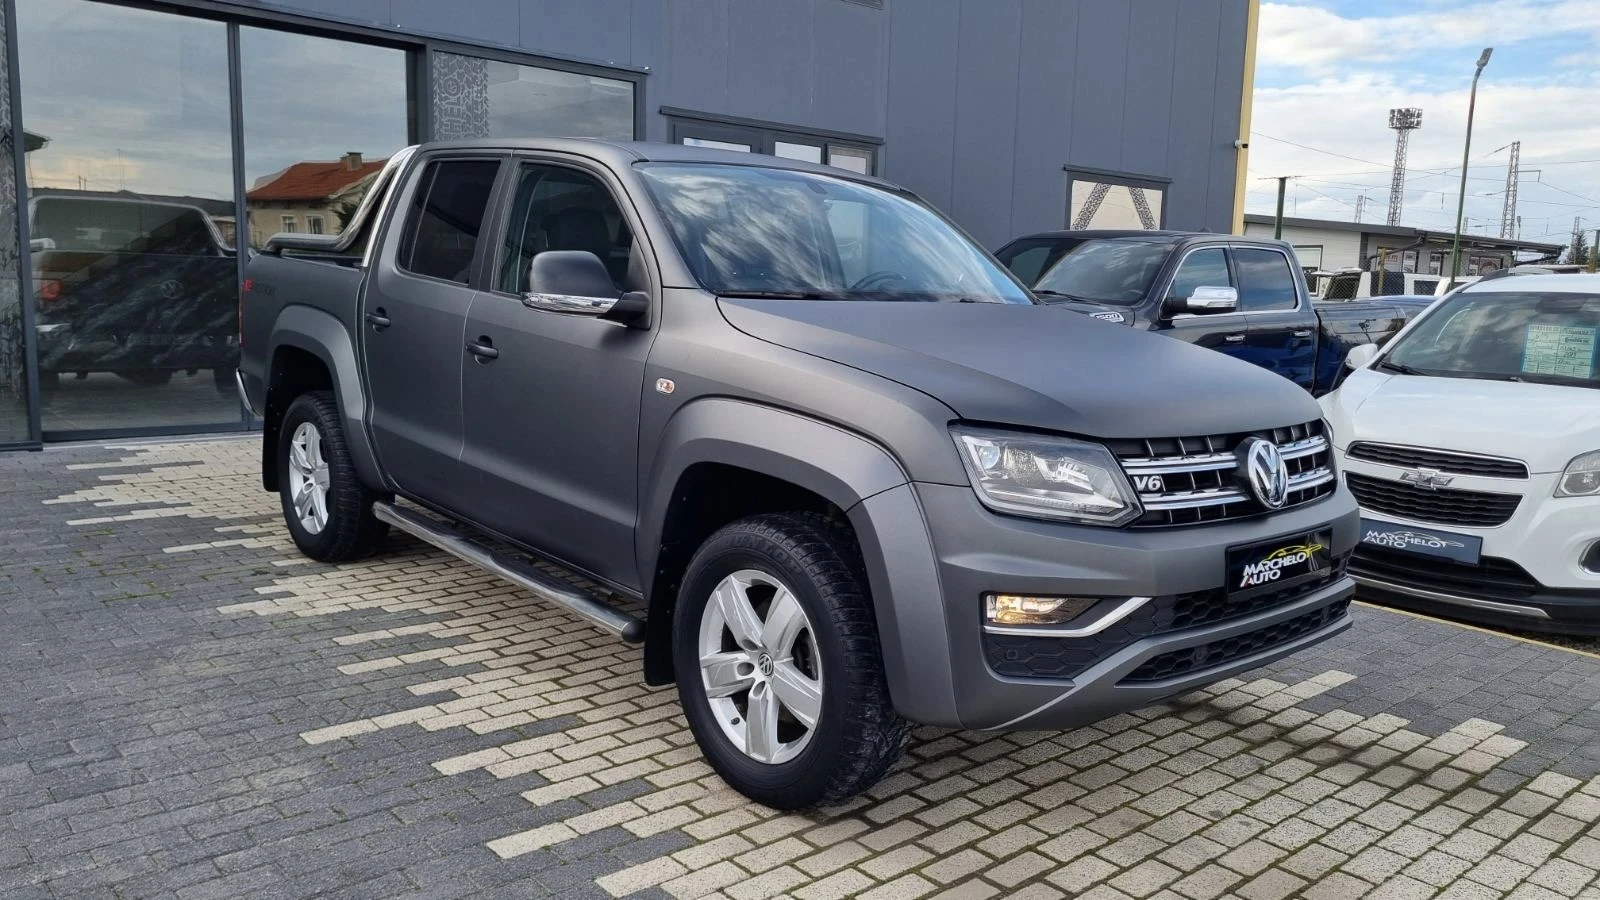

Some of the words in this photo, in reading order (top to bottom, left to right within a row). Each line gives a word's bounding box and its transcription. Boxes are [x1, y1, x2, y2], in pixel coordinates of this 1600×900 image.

[1133, 475, 1161, 491] V6
[1362, 536, 1406, 548] AUTO
[1240, 569, 1280, 588] AUTO
